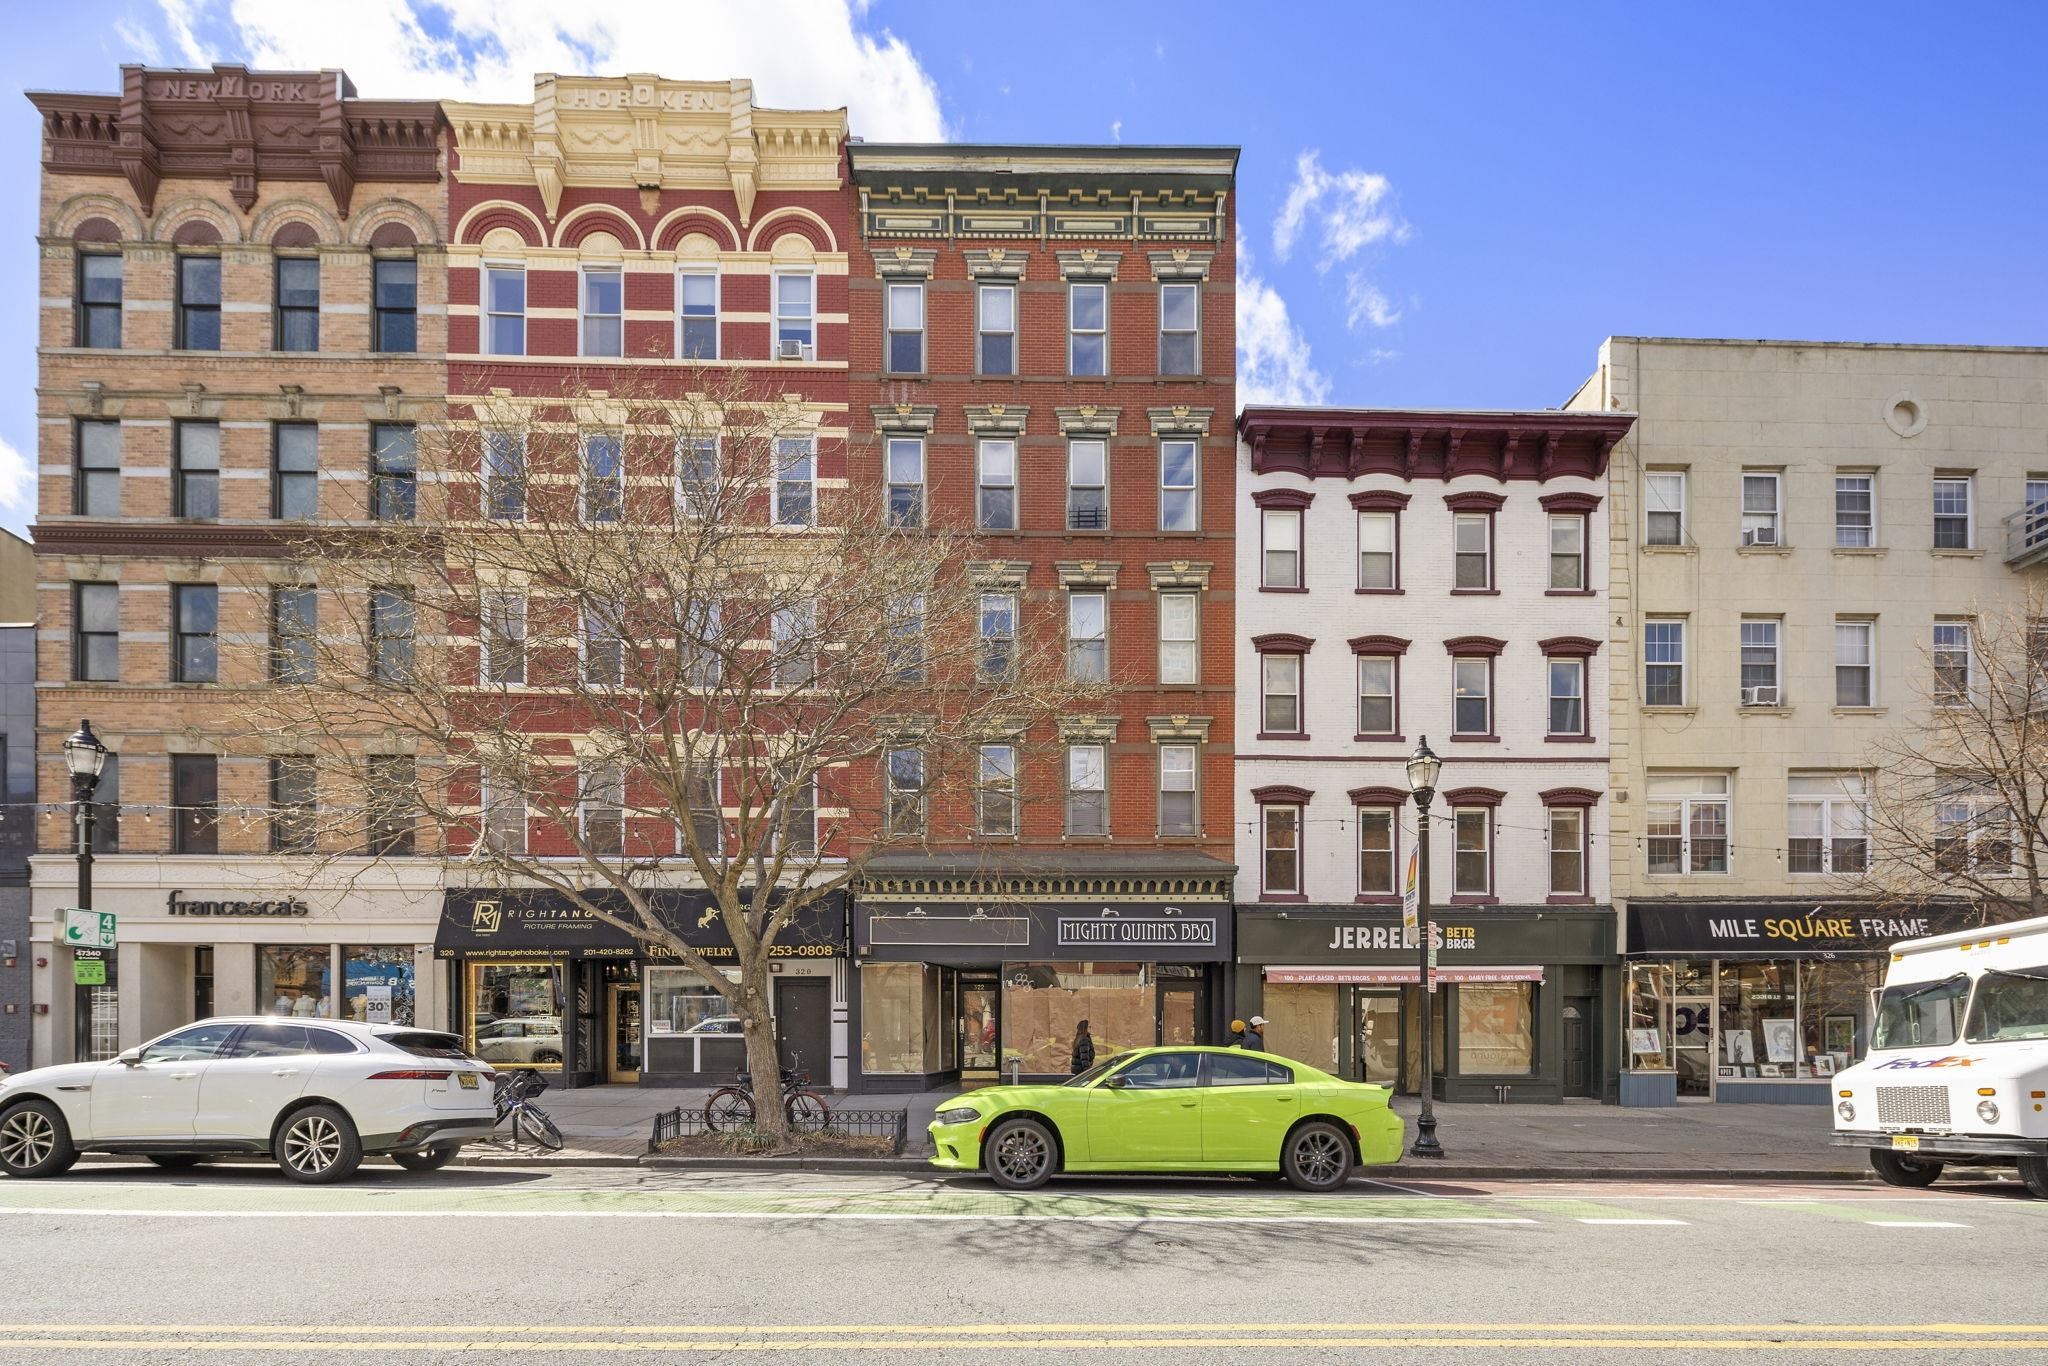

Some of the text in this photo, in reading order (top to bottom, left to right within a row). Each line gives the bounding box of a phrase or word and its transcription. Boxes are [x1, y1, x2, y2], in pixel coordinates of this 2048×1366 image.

[165, 76, 305, 100] NEW YORK
[574, 88, 714, 110] HOBOKEN
[166, 889, 308, 916] francesca's
[507, 909, 613, 918] RIGHTANGE
[102, 915, 113, 929] 4
[1709, 918, 1932, 941] MILE SQUARE FRAME
[1062, 923, 1211, 942] MIGHTY QUINN'S BBQ
[1446, 927, 1476, 938] BETR
[769, 945, 833, 956] 253-0808
[1446, 939, 1476, 949] BRGR
[1873, 1055, 1988, 1071] FedEx
